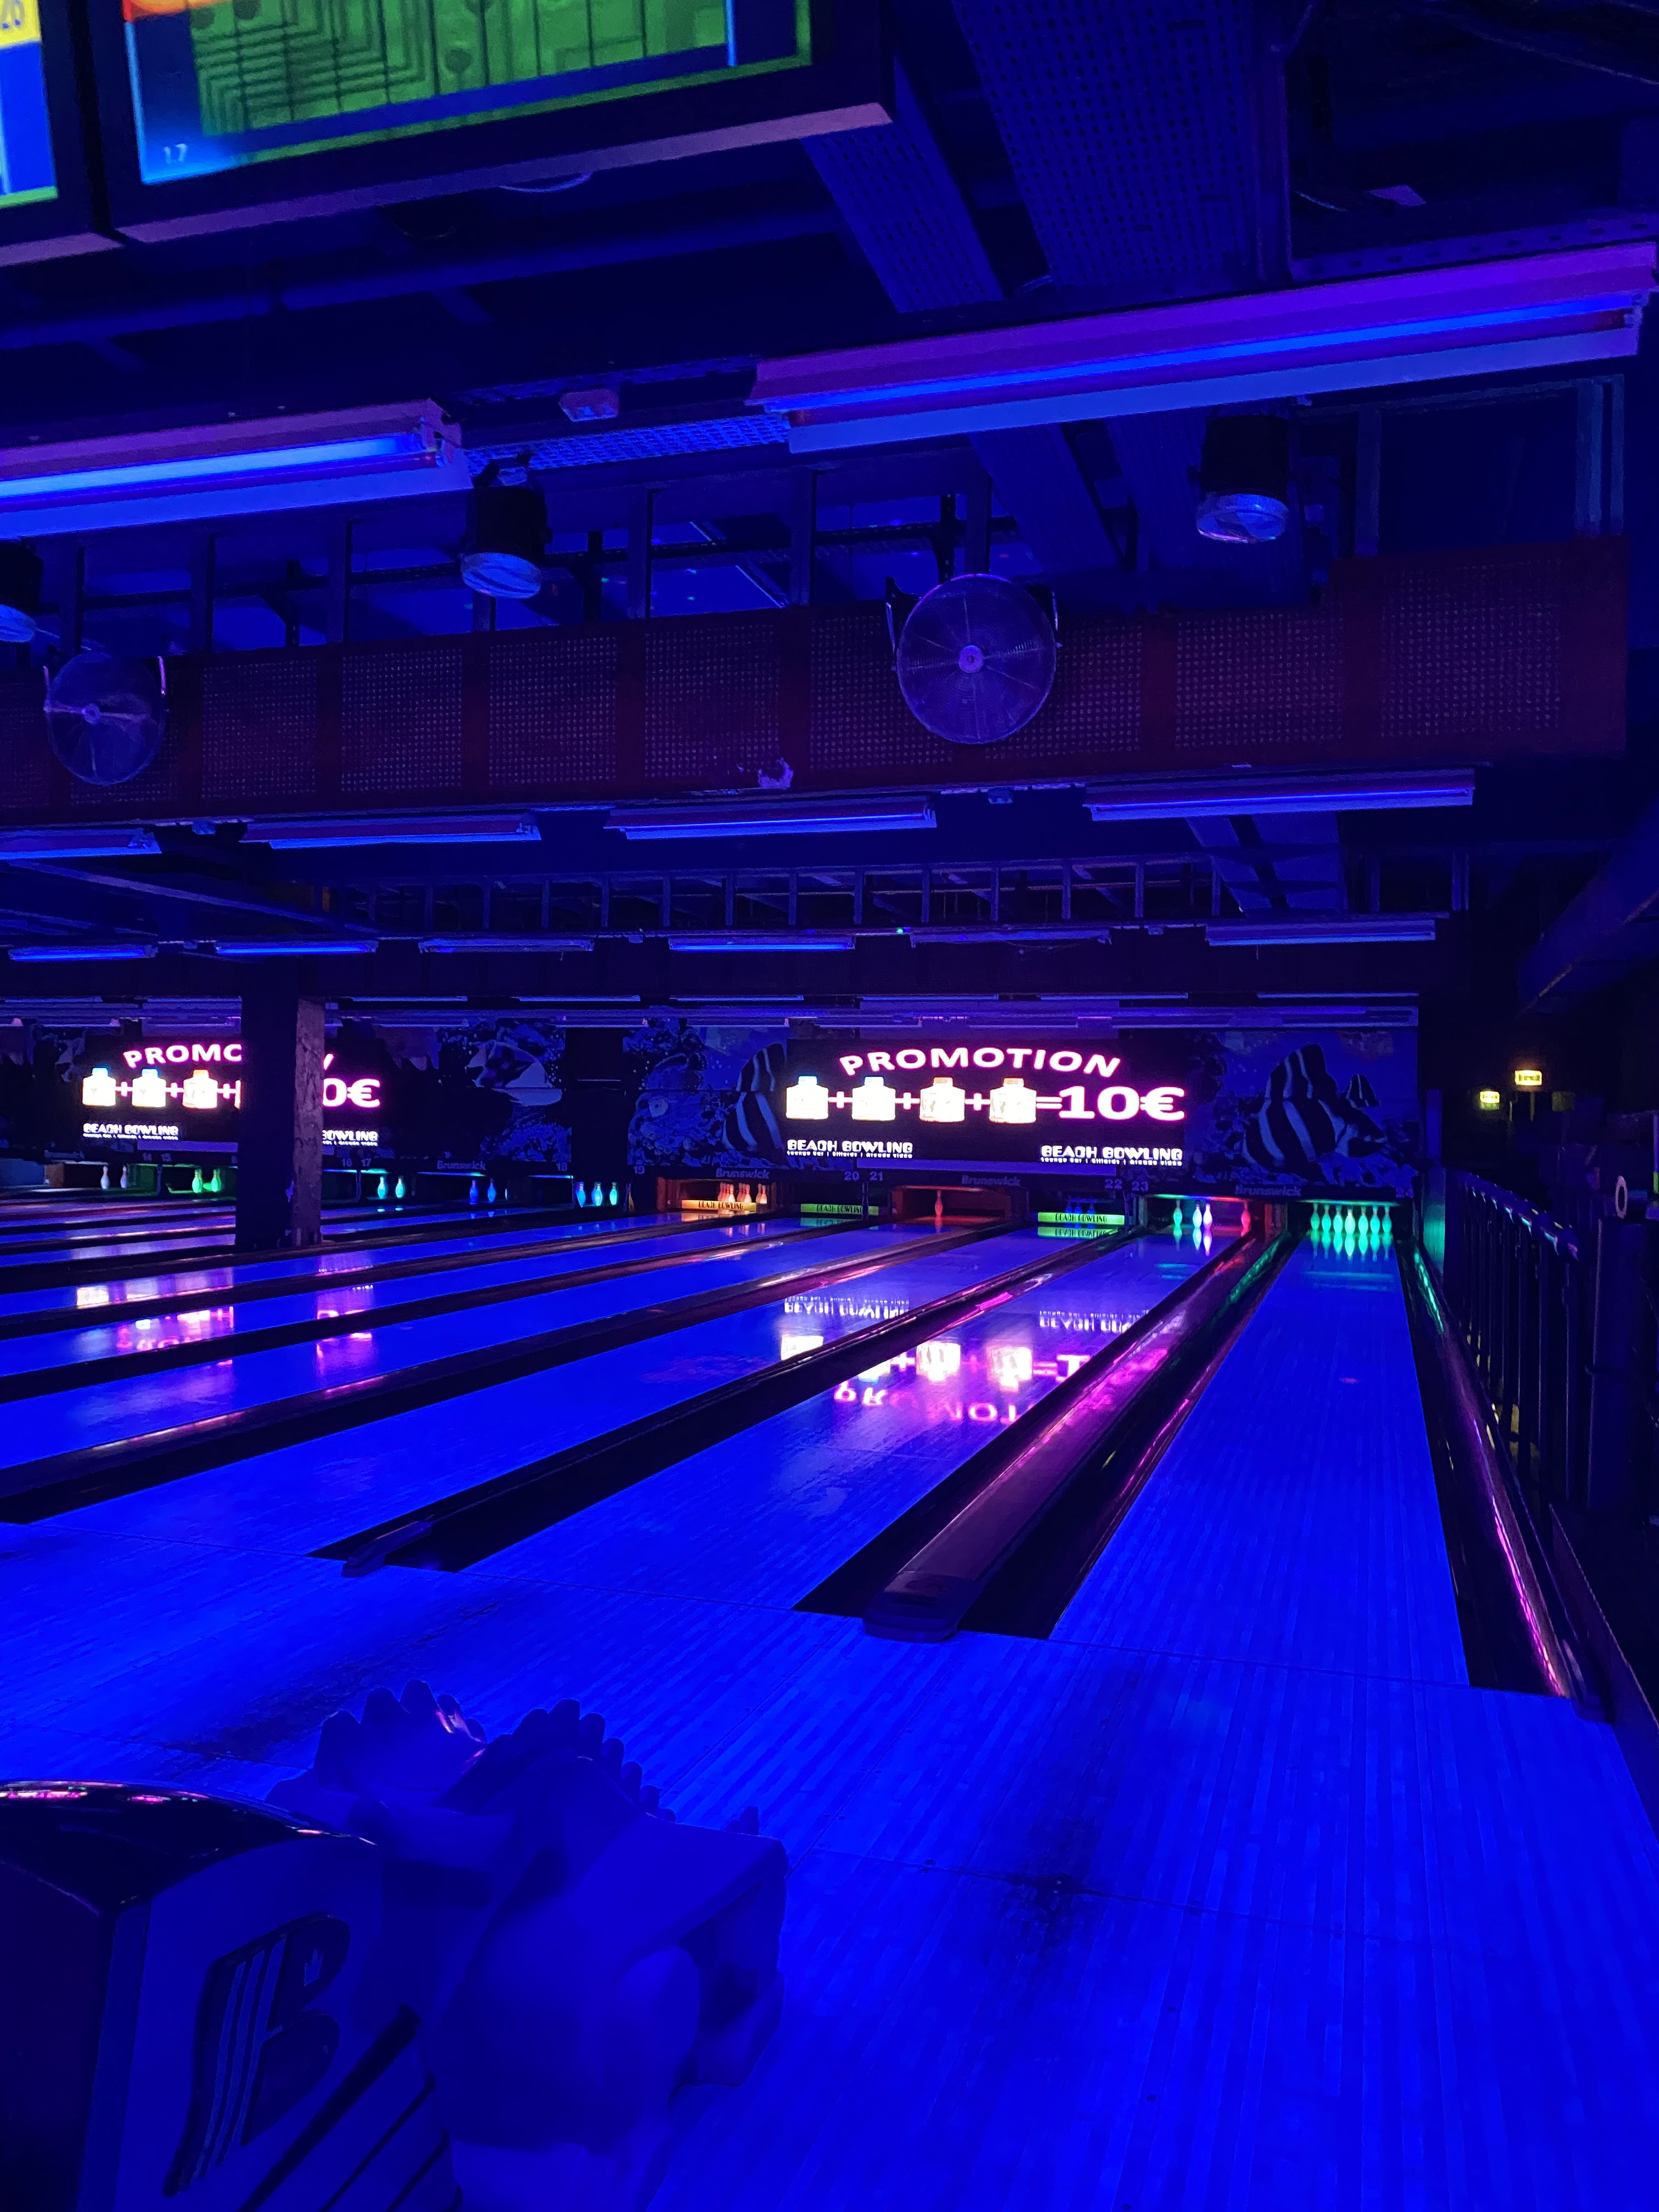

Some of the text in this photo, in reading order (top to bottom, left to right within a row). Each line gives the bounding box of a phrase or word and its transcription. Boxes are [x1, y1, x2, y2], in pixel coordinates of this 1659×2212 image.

[163, 143, 187, 163] 17
[123, 1043, 242, 1068] PROMO
[839, 1047, 1121, 1077] PROMOTION
[787, 1139, 913, 1153] BEACH BOWLING
[1041, 1146, 1182, 1160] BEACH BOWLING
[361, 1158, 372, 1167] 17
[634, 1165, 645, 1174] 19
[715, 1167, 770, 1178] Brunswick
[844, 1171, 860, 1181] 20
[870, 1171, 883, 1181] 21
[1104, 1178, 1122, 1189] 22
[1131, 1180, 1149, 1191] 23
[1078, 1214, 1107, 1222] BOWLING
